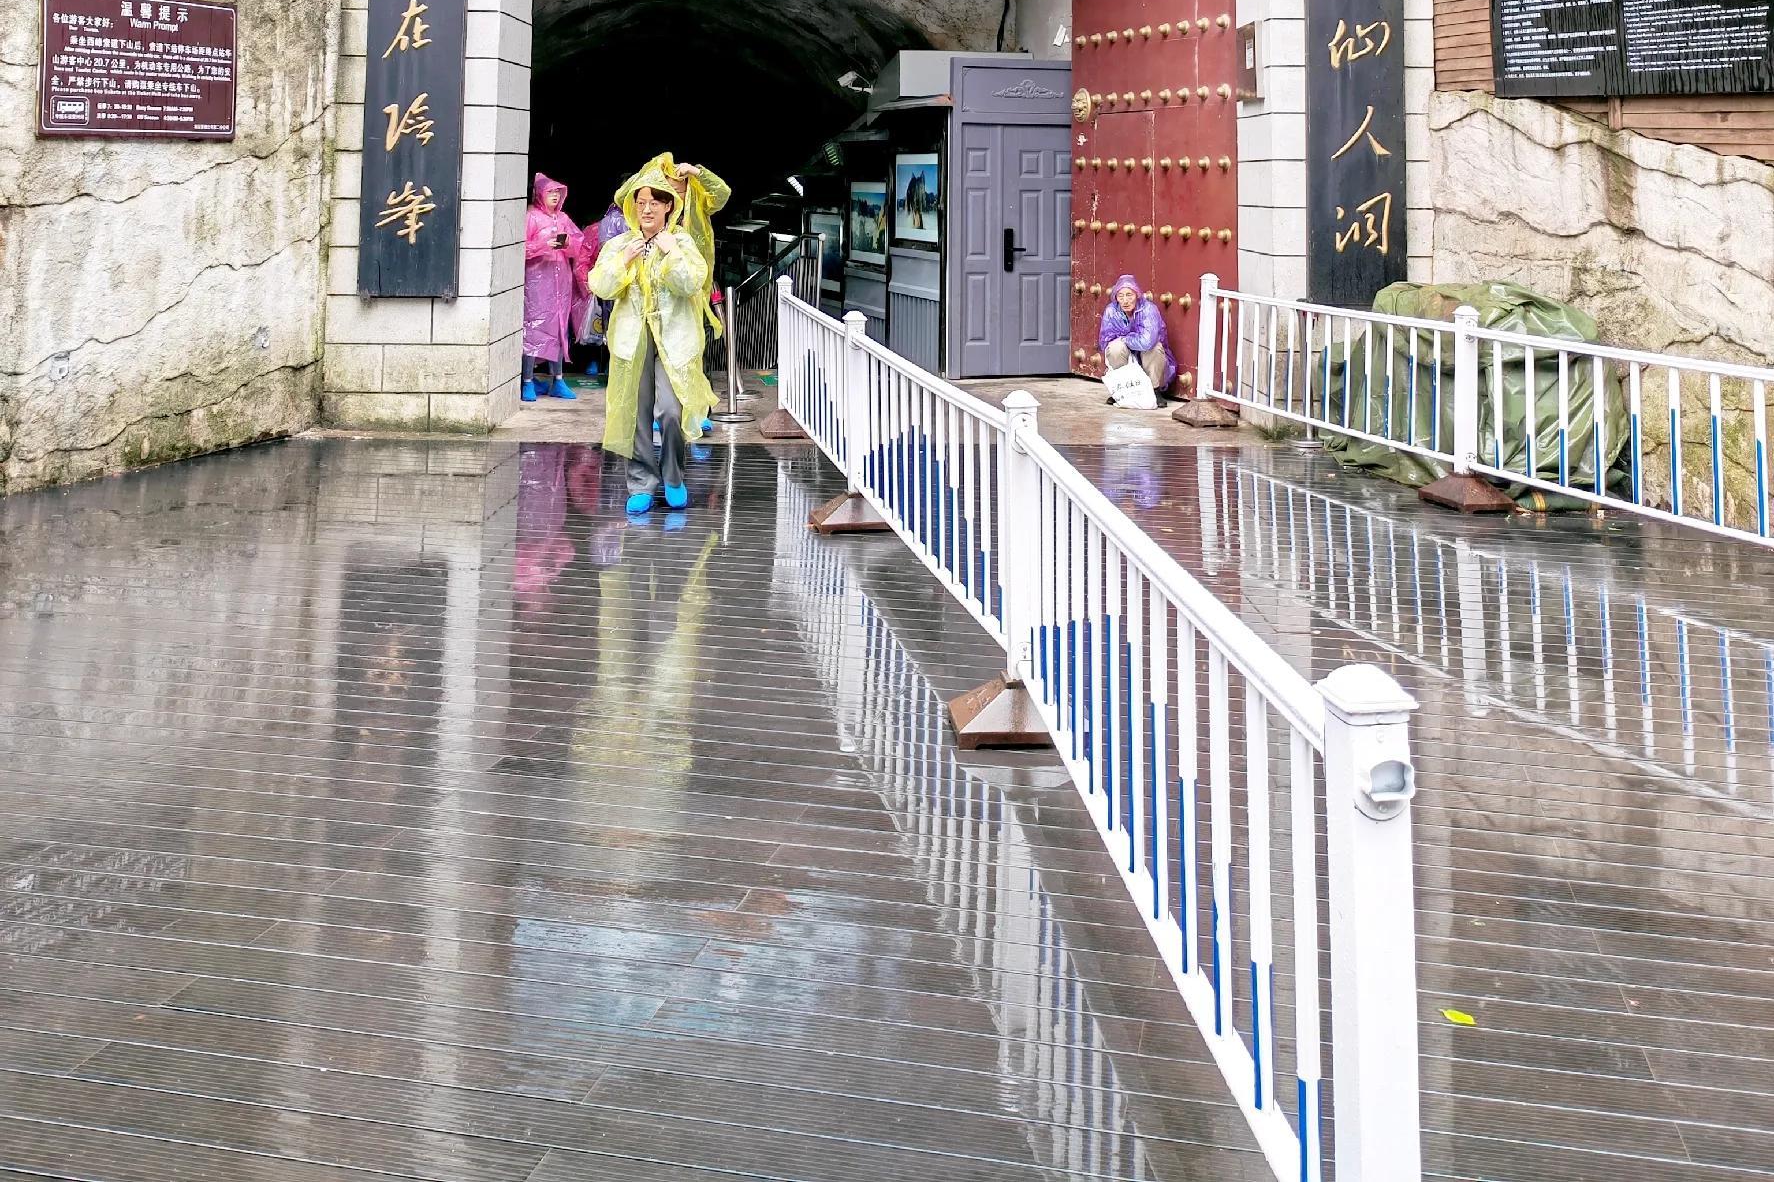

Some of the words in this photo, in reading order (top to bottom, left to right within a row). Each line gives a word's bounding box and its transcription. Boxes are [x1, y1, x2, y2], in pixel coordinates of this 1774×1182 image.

[120, 0, 189, 23] 温馨提示
[129, 17, 152, 29] Warm
[153, 20, 179, 33] Prompt
